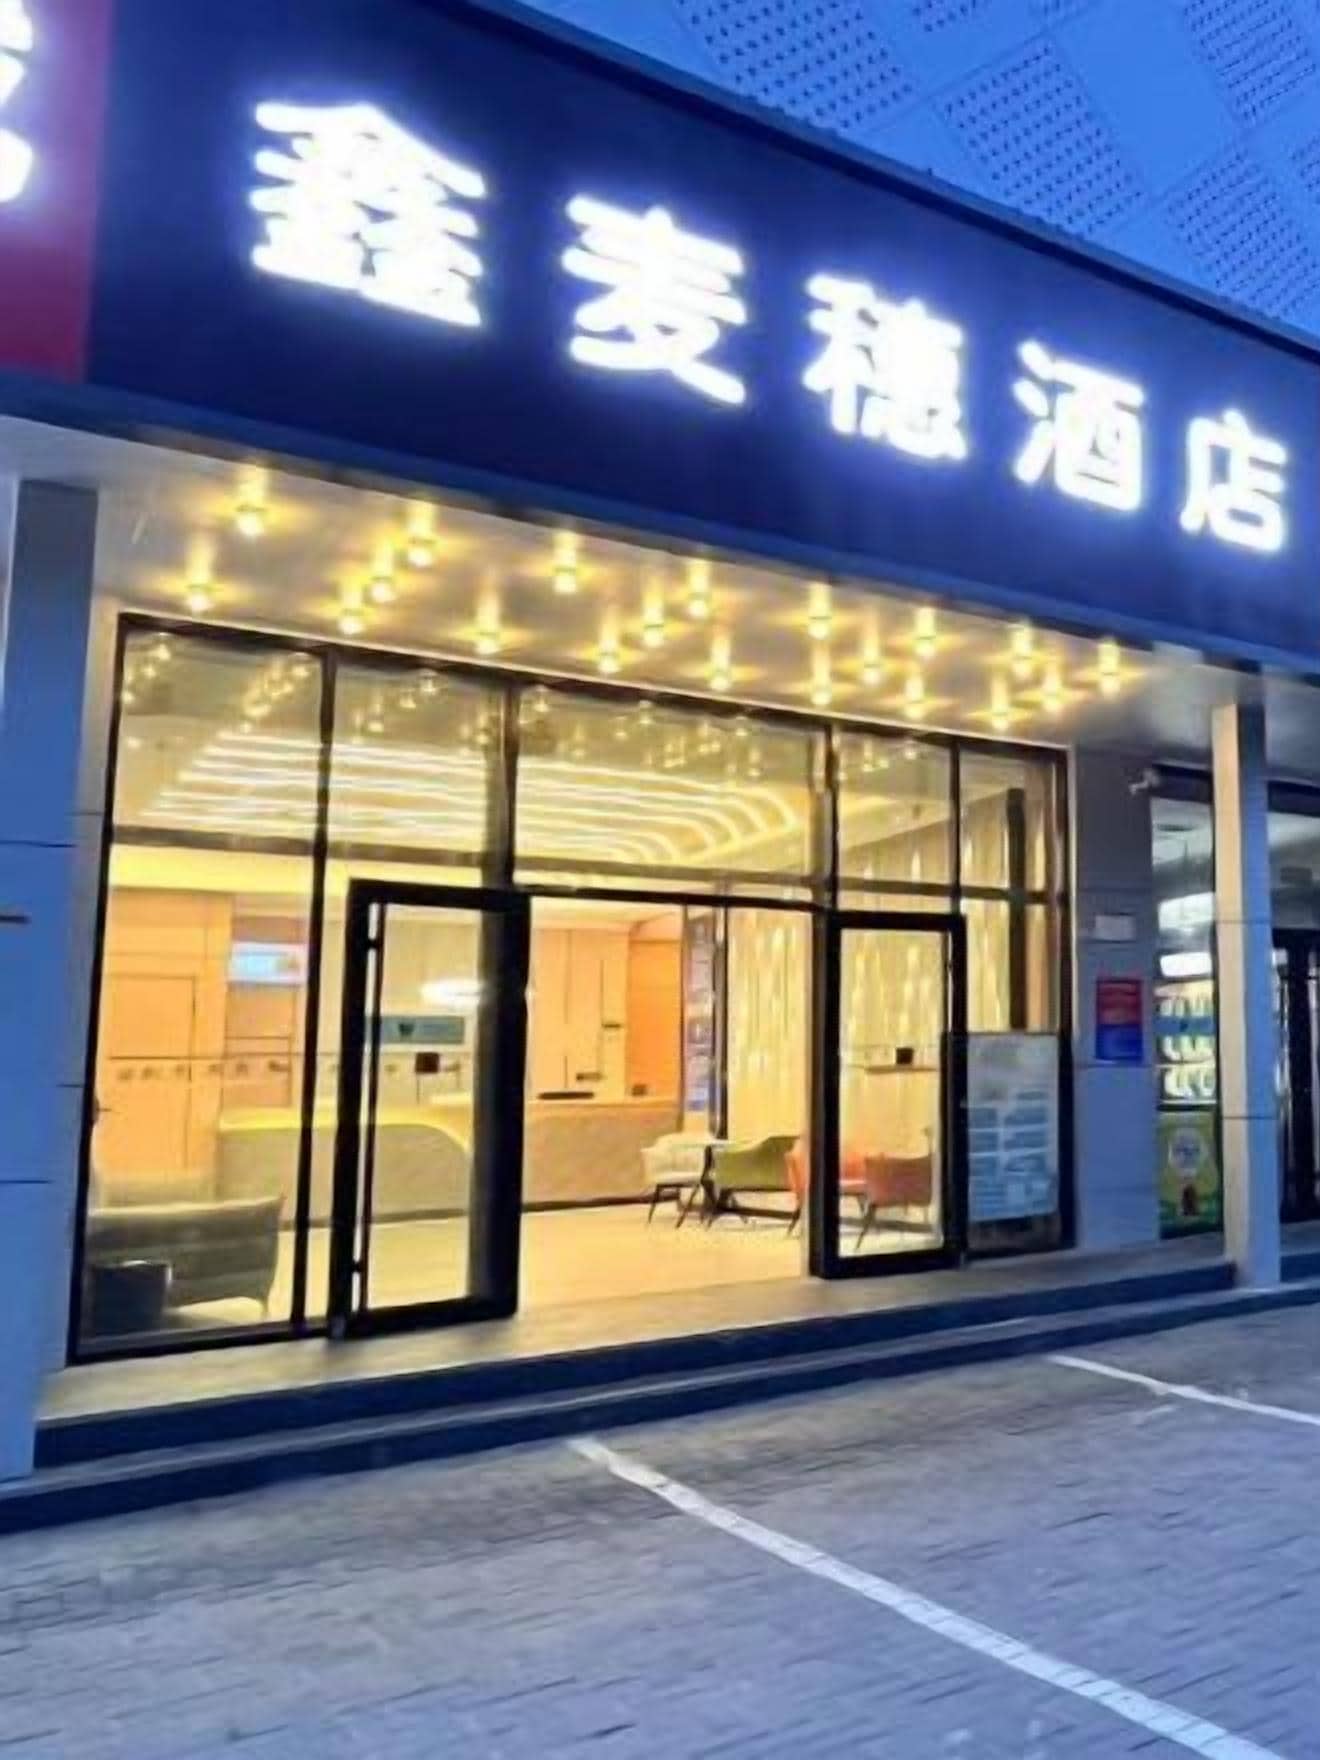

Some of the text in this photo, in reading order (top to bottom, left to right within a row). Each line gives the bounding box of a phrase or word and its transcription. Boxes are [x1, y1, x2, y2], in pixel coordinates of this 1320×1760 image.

[250, 101, 1289, 554] 鑫麦穗酒店
